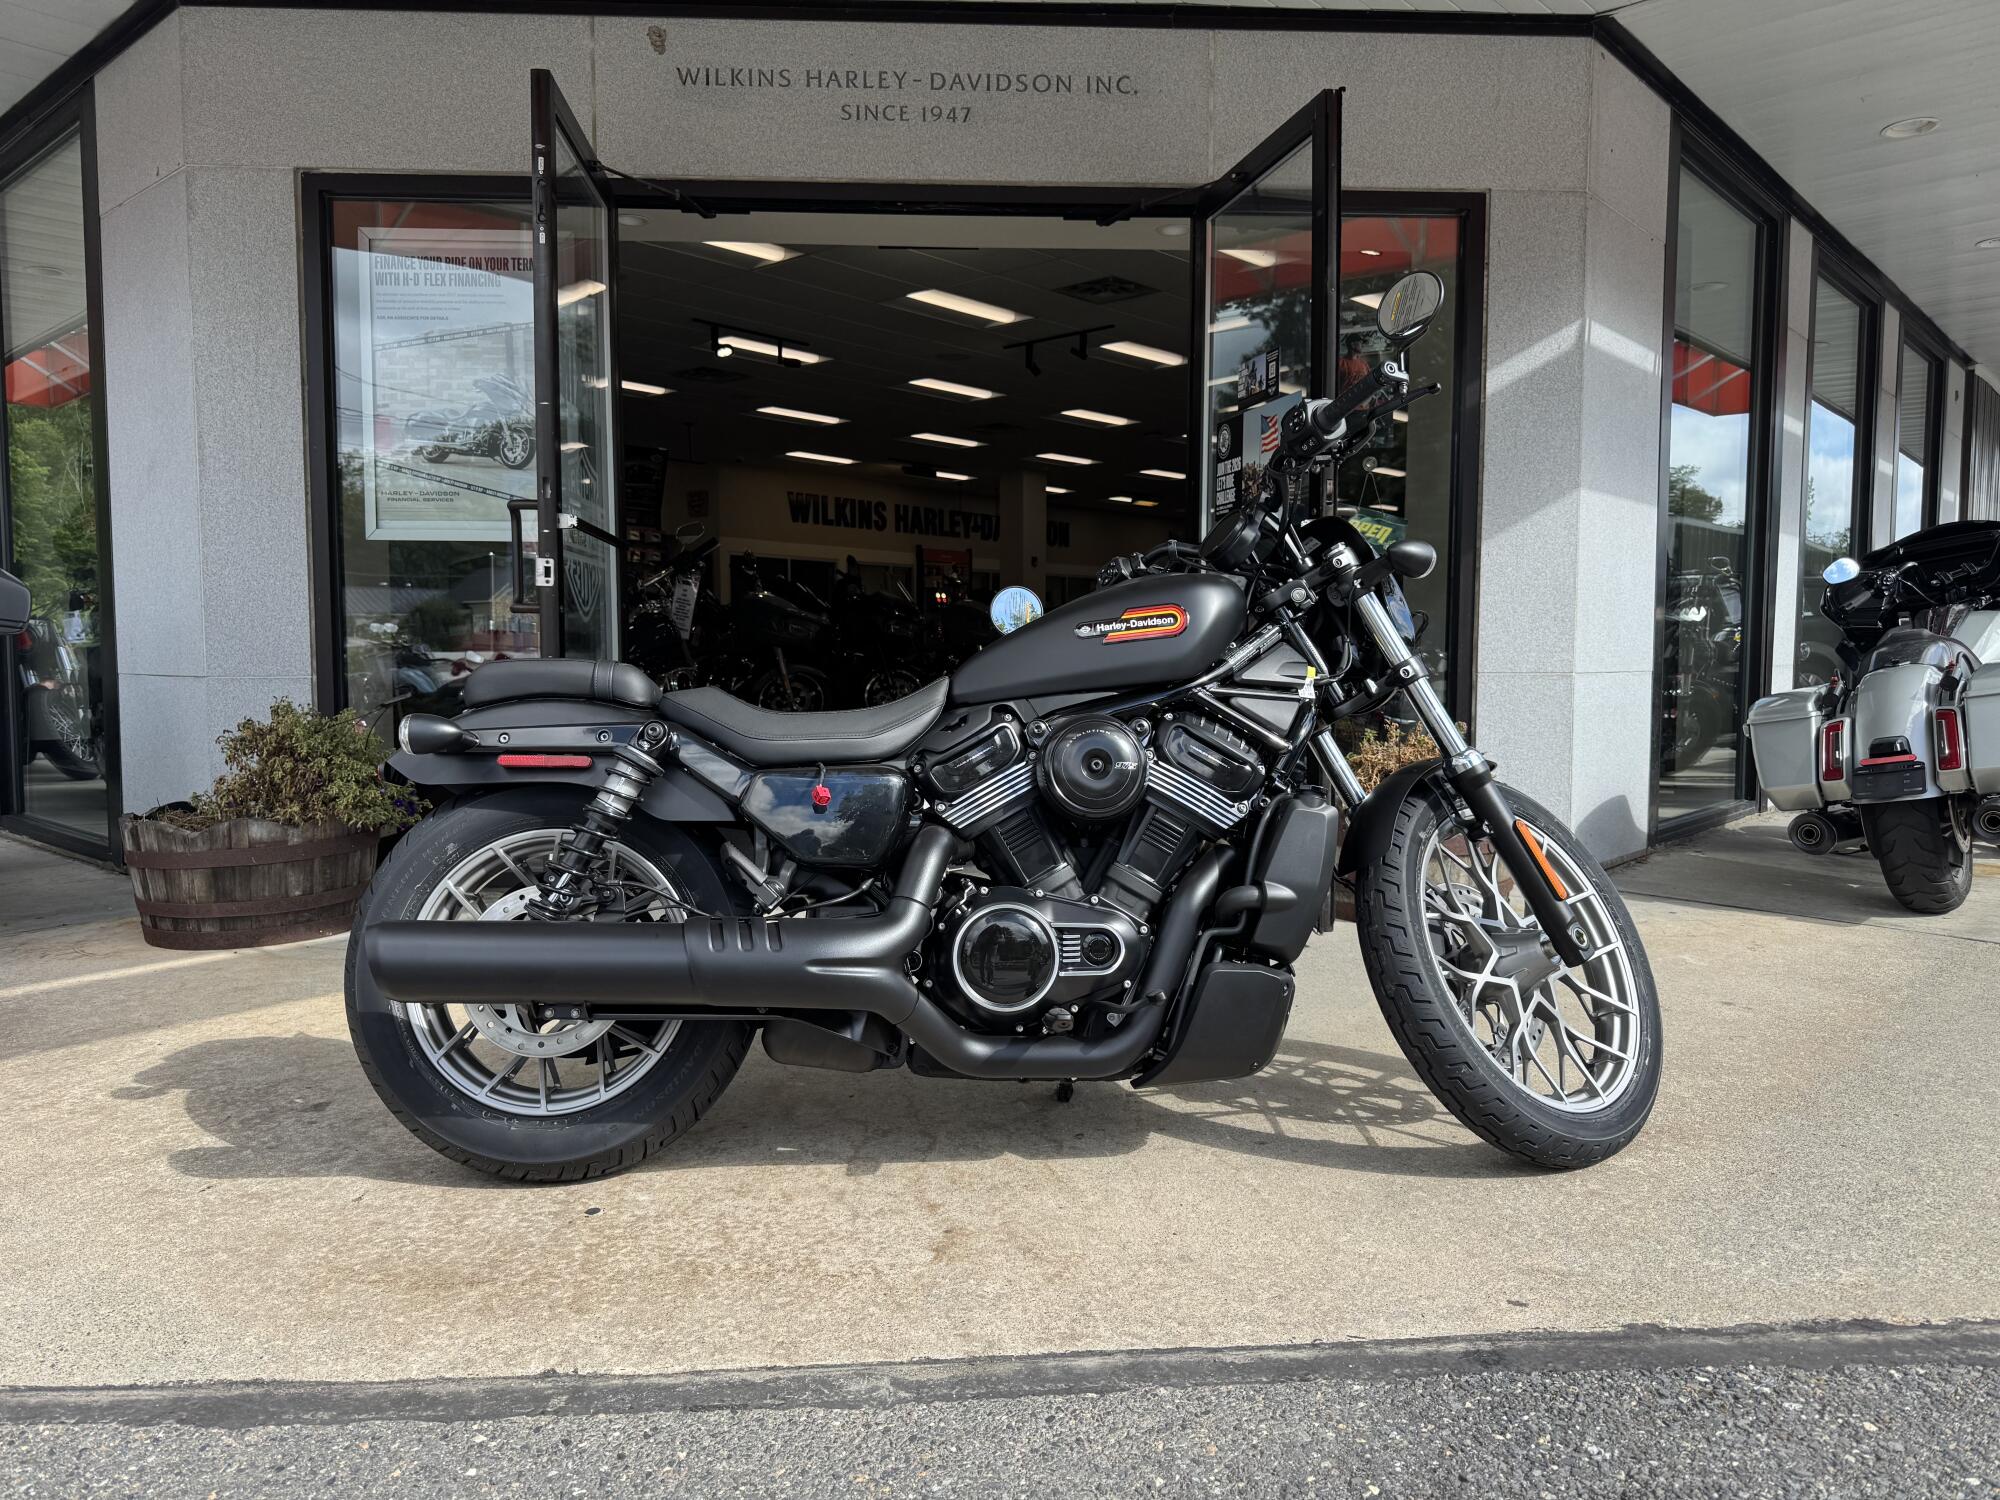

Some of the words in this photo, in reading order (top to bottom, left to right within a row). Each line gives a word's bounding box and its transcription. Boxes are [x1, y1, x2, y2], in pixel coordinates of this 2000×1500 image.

[676, 66, 792, 89] WILKINS
[804, 70, 1073, 95] HARLEY-DAVIDSON
[1085, 75, 1139, 96] INC.
[840, 104, 911, 122] SINCE
[921, 105, 972, 124] 1947
[374, 255, 416, 270] FINANCE
[417, 256, 443, 270] YOUR
[444, 256, 467, 271] RIDE
[469, 256, 483, 271] ON
[484, 257, 509, 272] YOUR
[375, 271, 401, 286] WITH
[424, 272, 447, 287] FLEX
[448, 272, 502, 288] FINANCING
[786, 490, 888, 531] WILKINS
[1096, 616, 1175, 633] Harley-Davidson
